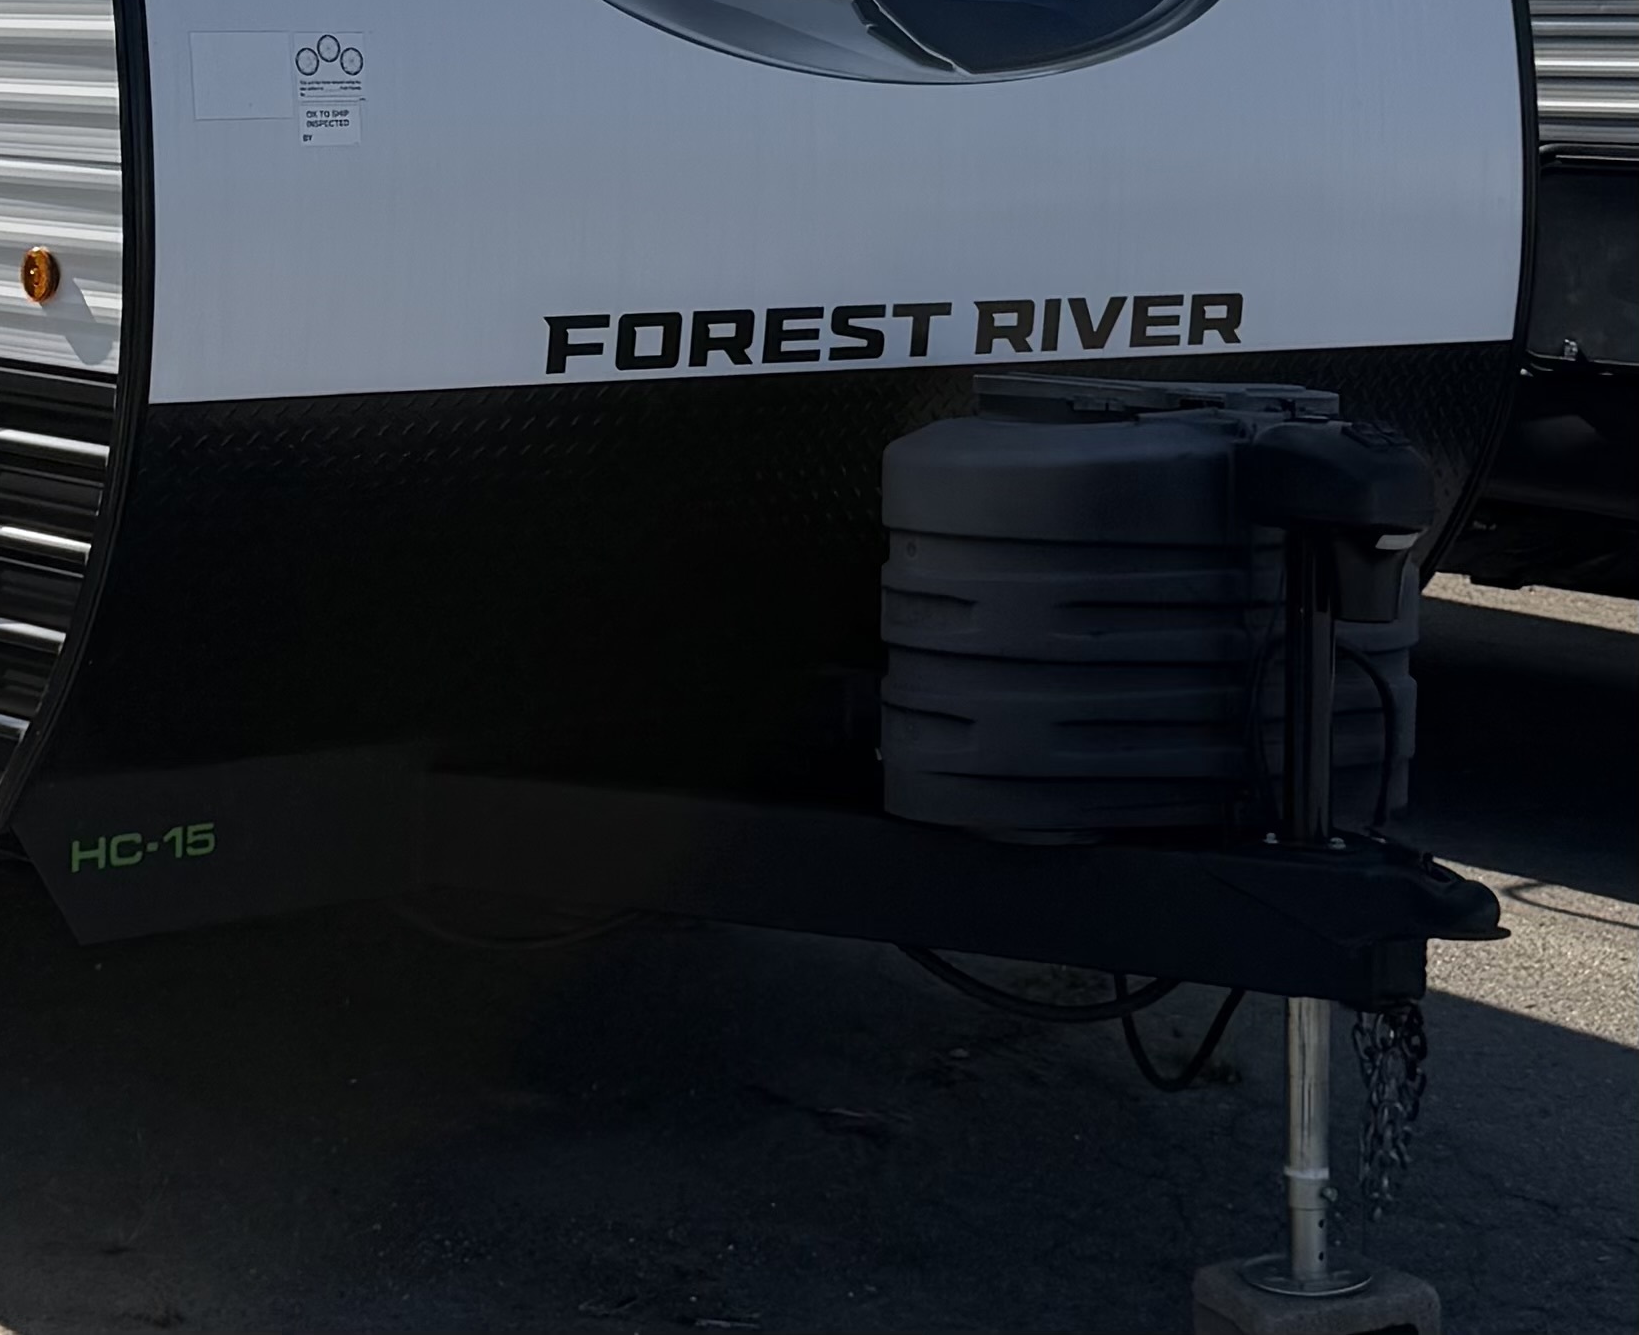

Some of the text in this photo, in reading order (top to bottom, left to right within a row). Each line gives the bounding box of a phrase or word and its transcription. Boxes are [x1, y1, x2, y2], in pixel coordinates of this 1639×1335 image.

[306, 109, 350, 119] OK TO SHIP
[306, 119, 350, 128] INSPECTED
[303, 134, 313, 142] BY
[543, 292, 1244, 374] FOREST RIVER
[71, 822, 216, 873] HC-15
